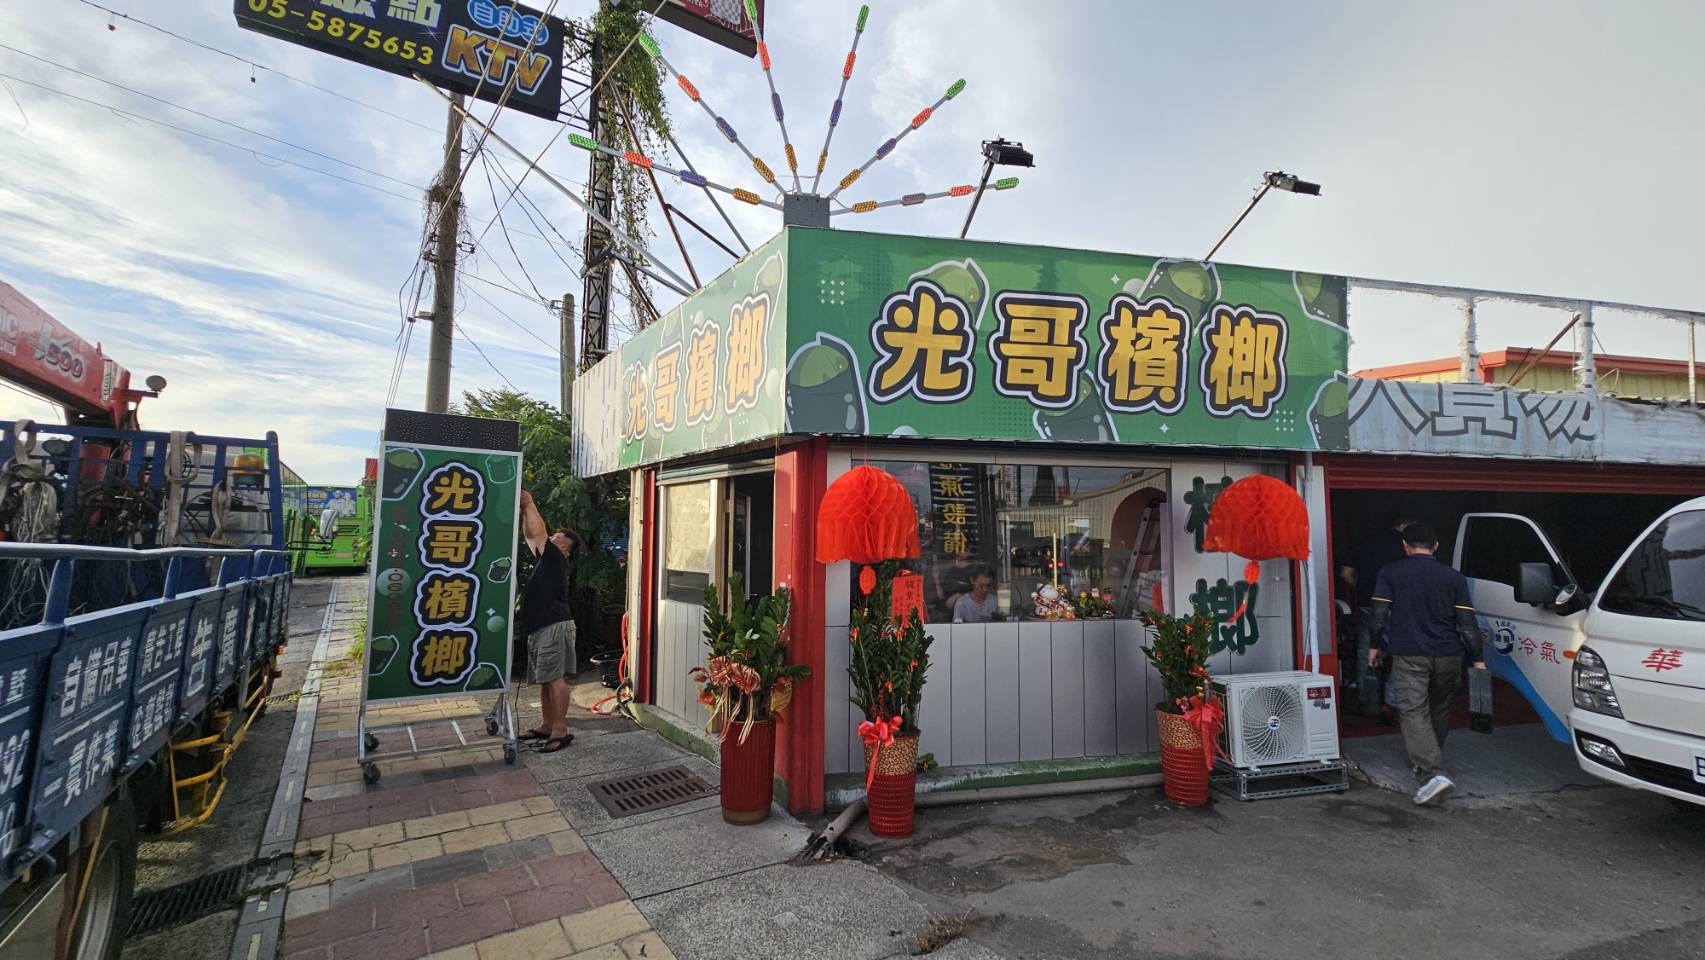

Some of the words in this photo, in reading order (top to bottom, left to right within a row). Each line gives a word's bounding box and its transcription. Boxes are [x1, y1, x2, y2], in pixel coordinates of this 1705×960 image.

[248, 0, 434, 65] 05-5875653
[474, 1, 545, 42] 自助式
[446, 27, 550, 92] KTV
[626, 302, 766, 440] 光哥檳榔
[880, 291, 1279, 409] 光哥檳榔
[420, 470, 476, 678] 光哥檳榔
[1517, 636, 1561, 665] 冷氣
[1641, 647, 1684, 673] 華
